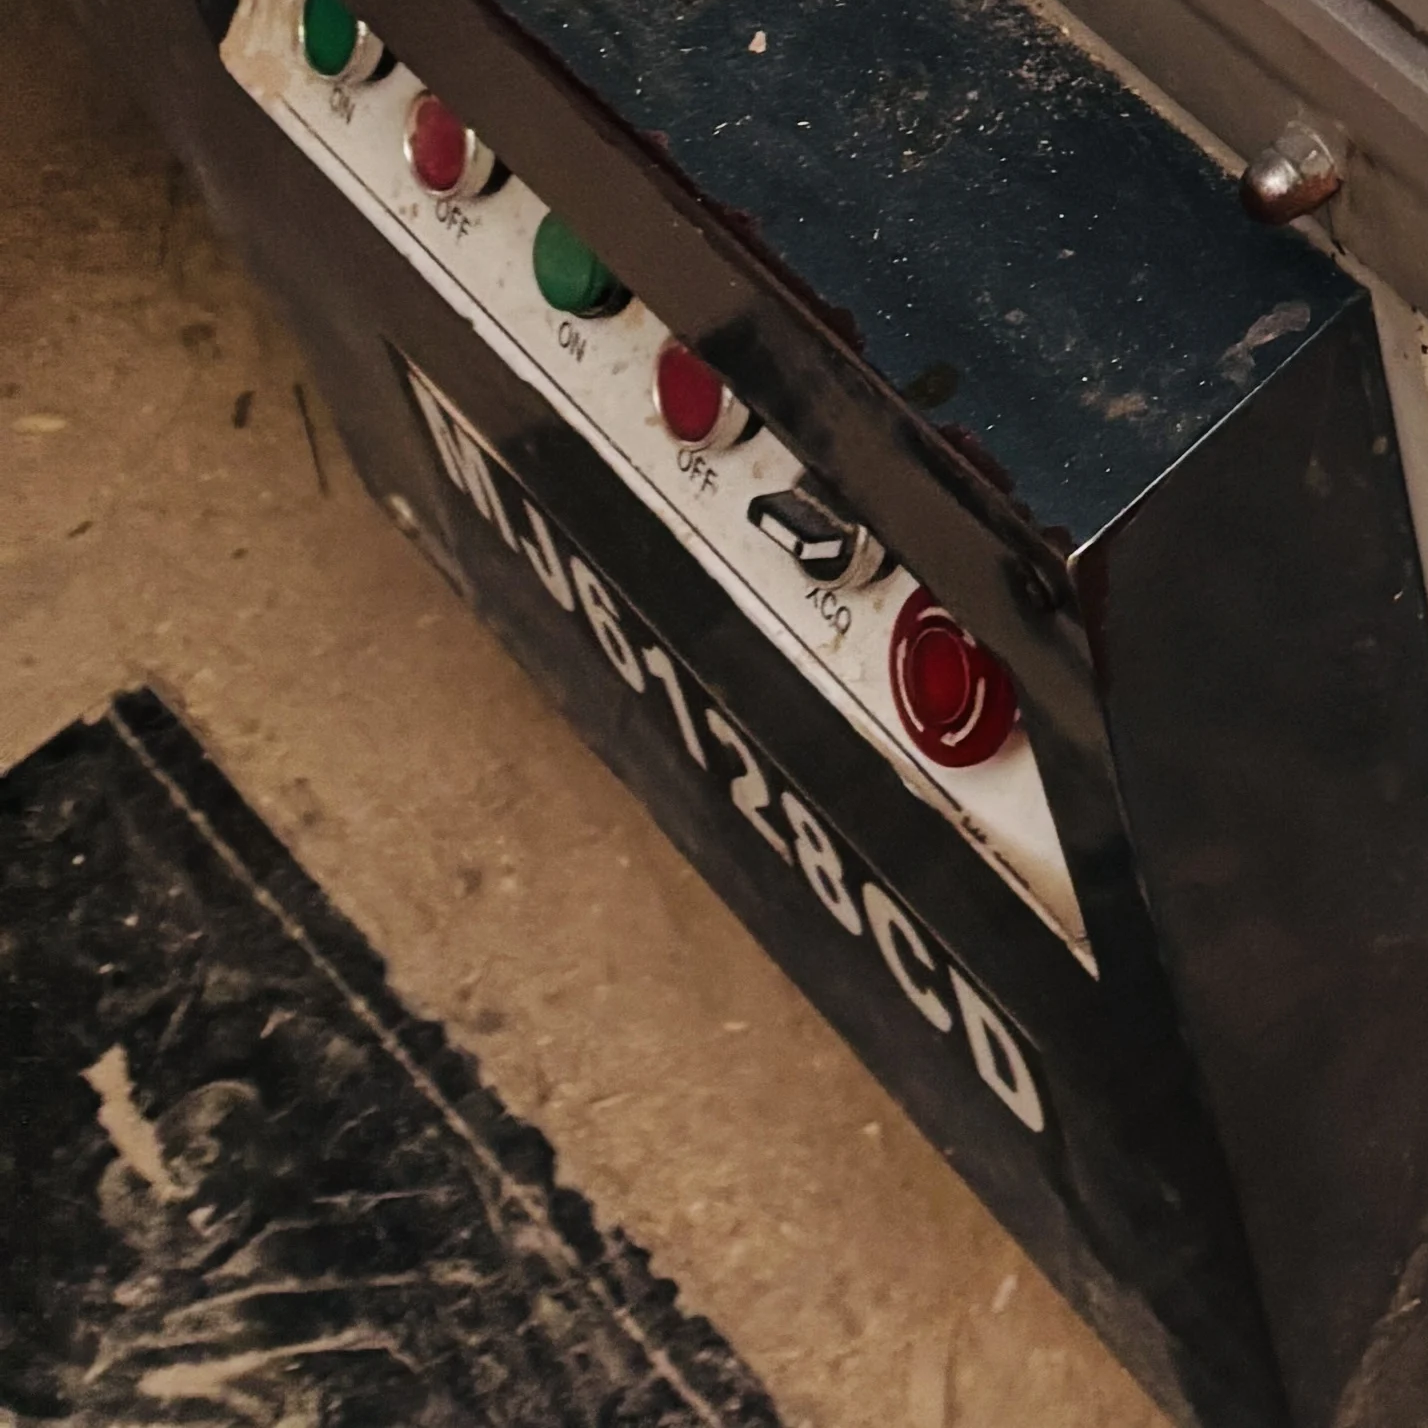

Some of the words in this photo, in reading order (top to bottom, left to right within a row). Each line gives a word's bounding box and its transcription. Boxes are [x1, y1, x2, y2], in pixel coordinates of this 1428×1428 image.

[436, 197, 469, 239] OFF
[558, 321, 587, 362] ON
[677, 448, 718, 492] OFF
[408, 372, 1043, 1132] MJ6128CD
